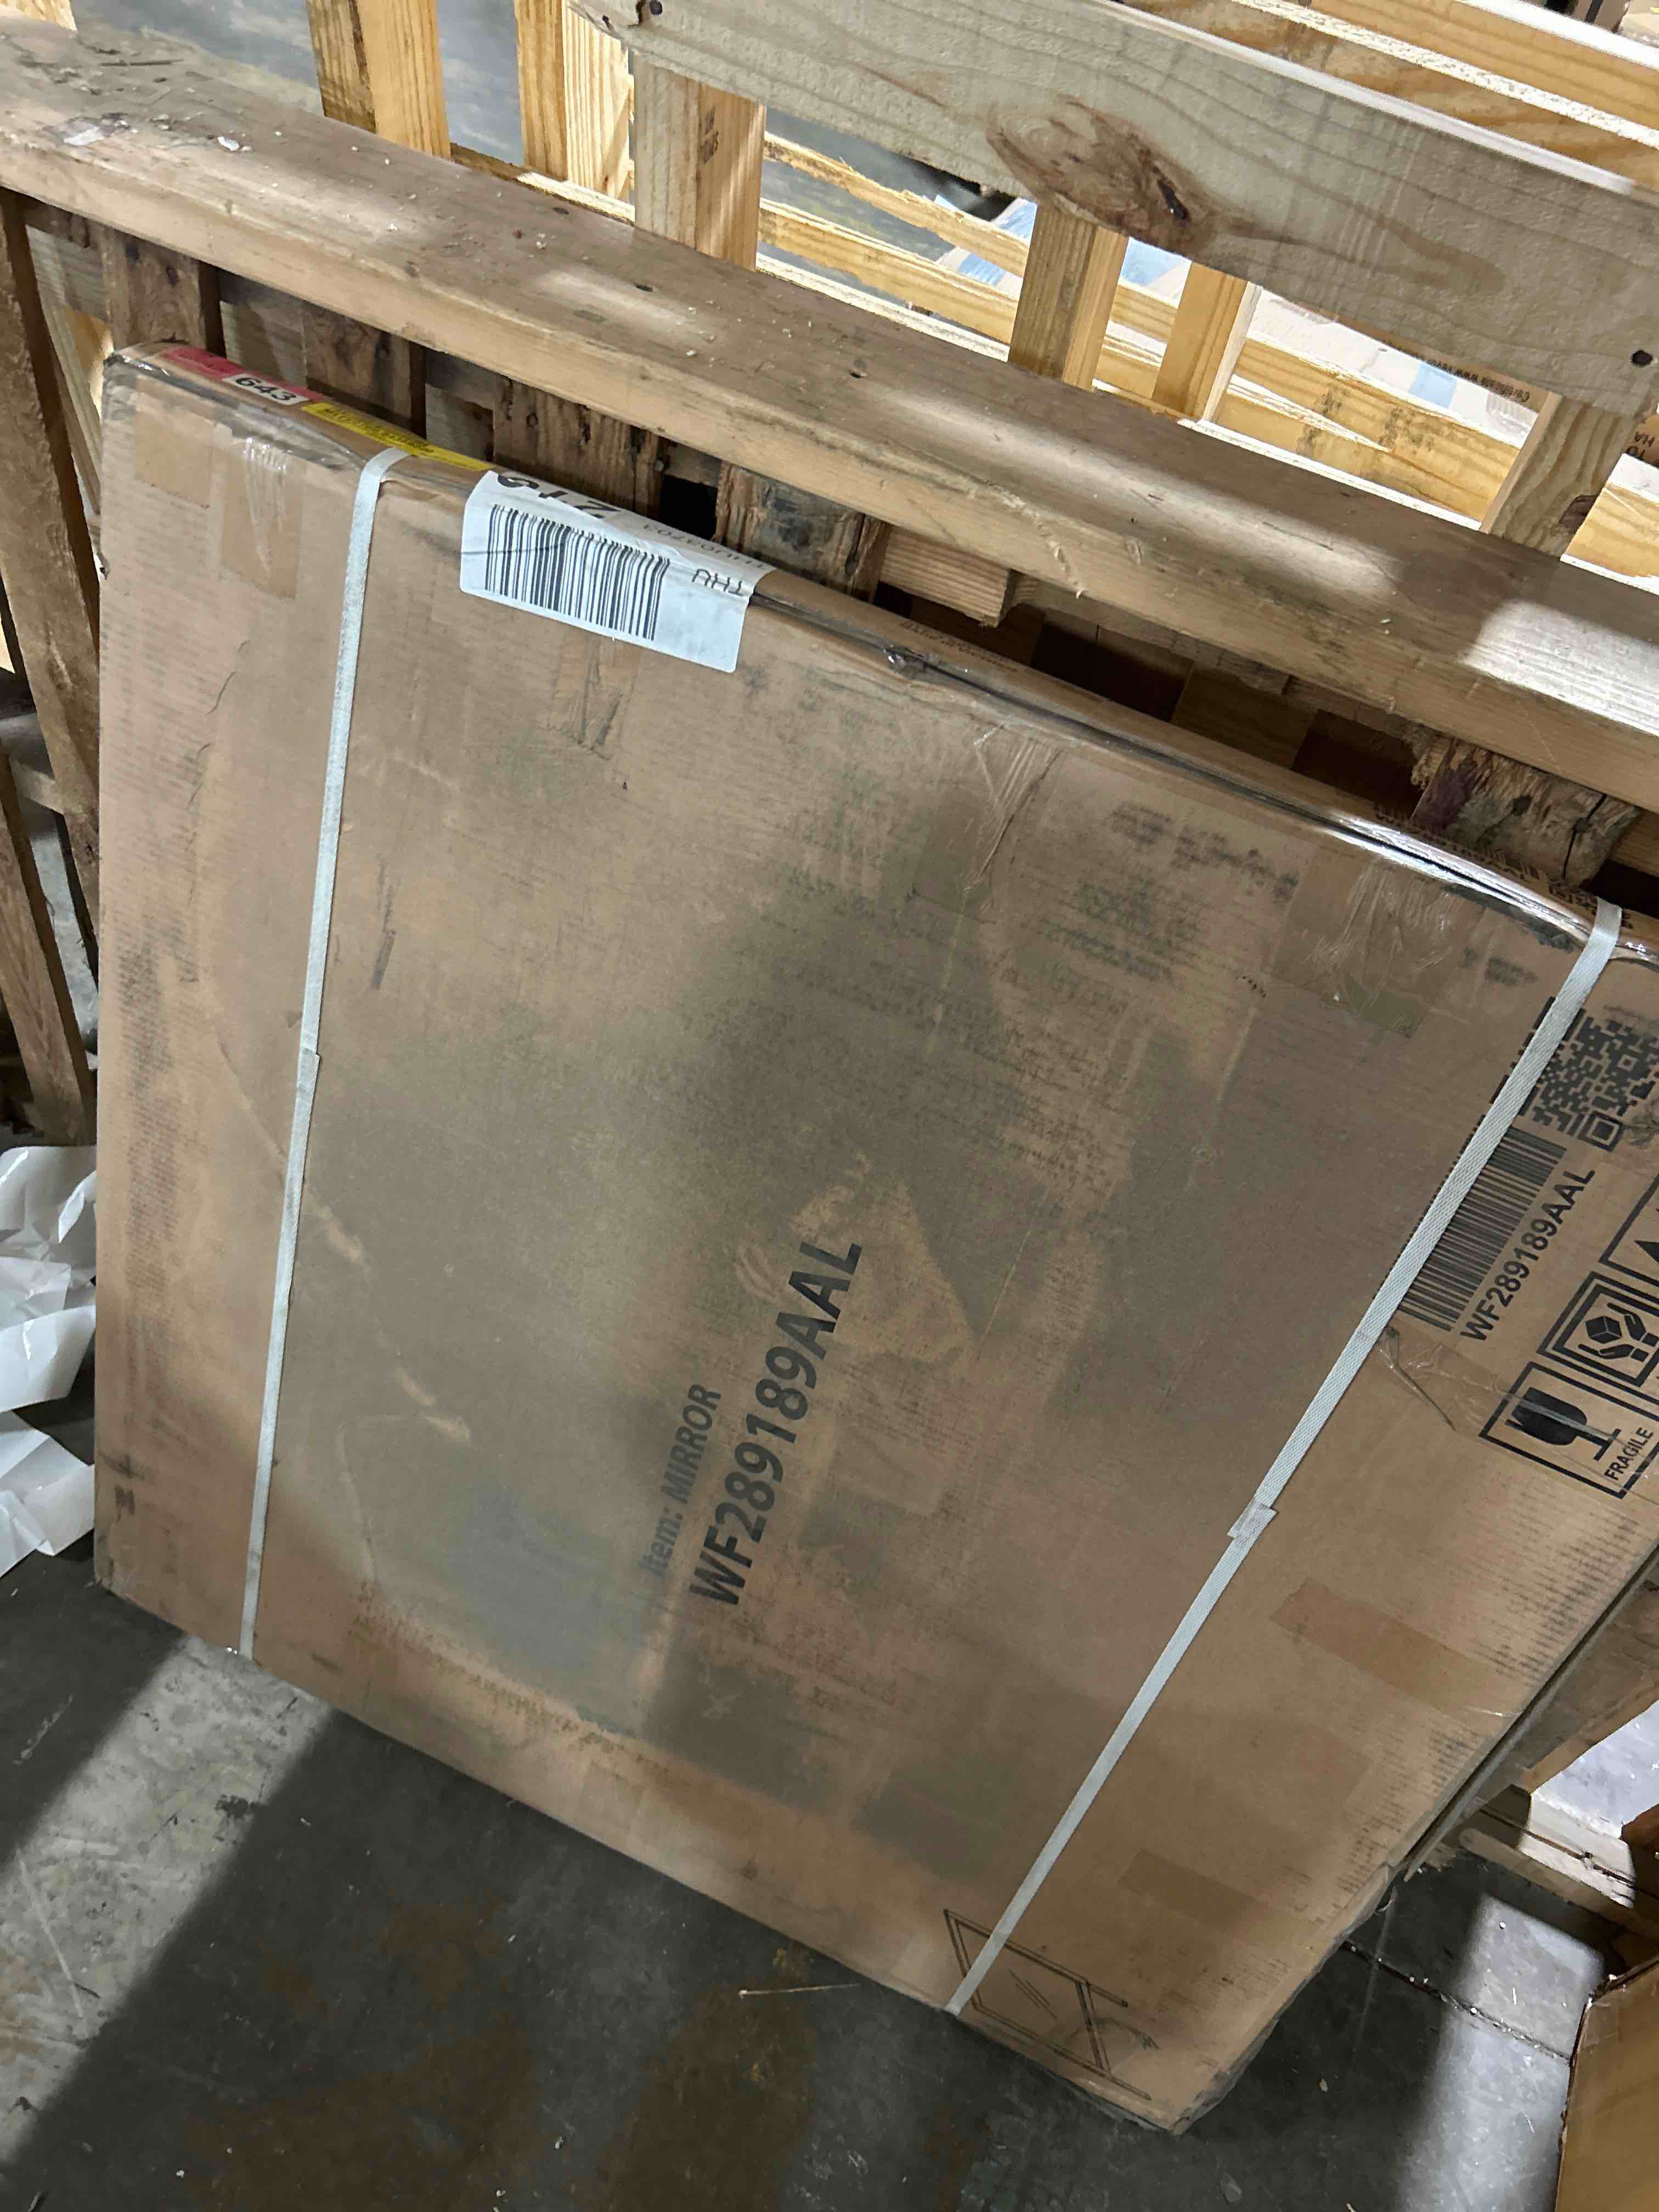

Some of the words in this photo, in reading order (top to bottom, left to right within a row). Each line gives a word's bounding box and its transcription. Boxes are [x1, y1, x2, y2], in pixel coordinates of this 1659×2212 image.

[235, 377, 297, 401] 643
[692, 569, 743, 596] THU
[1460, 1169, 1595, 1342] WF289189AAL
[661, 1384, 721, 1504] MIRROR
[689, 1242, 863, 1606] WF289189AAL
[1604, 1427, 1653, 1481] FRAGILE
